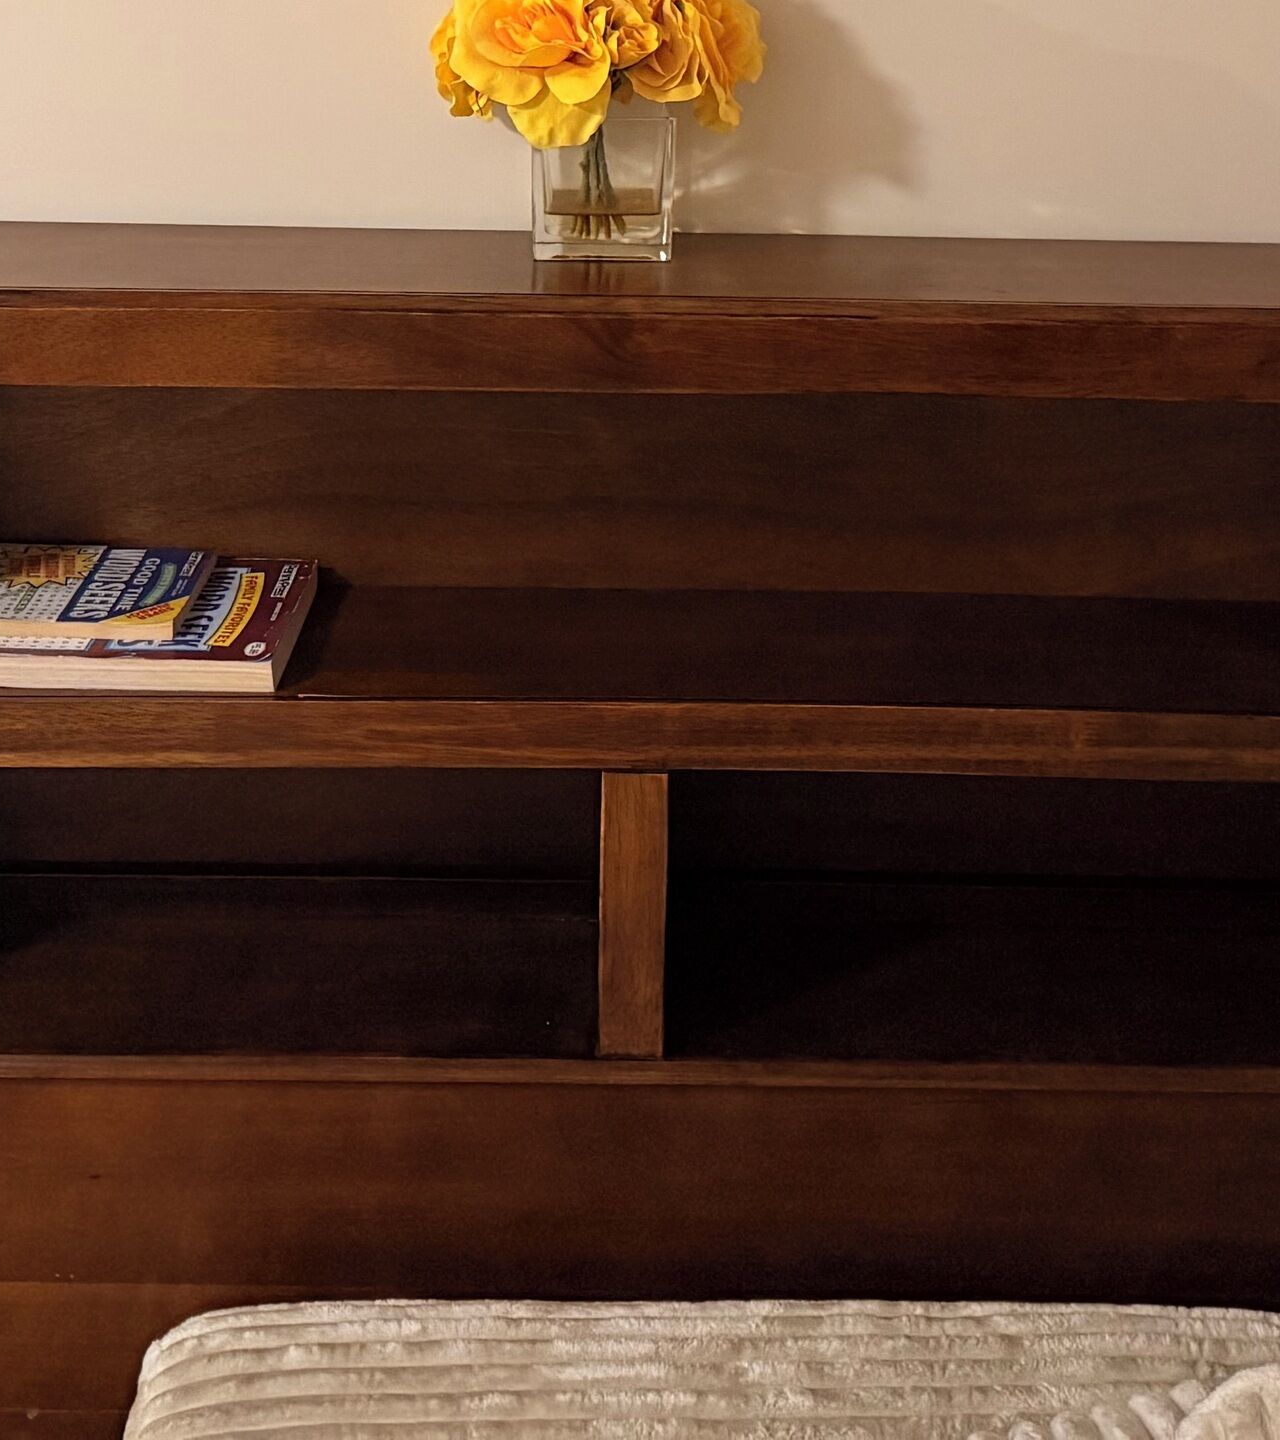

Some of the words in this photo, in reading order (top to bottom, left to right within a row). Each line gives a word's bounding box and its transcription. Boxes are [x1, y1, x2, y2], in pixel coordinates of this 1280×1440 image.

[93, 548, 148, 582] WORD
[134, 558, 161, 586] GOOD
[68, 582, 127, 619] SEEKS
[114, 587, 143, 612] TIME
[243, 575, 259, 599] FAMILY
[214, 598, 252, 644] FAVORITES
